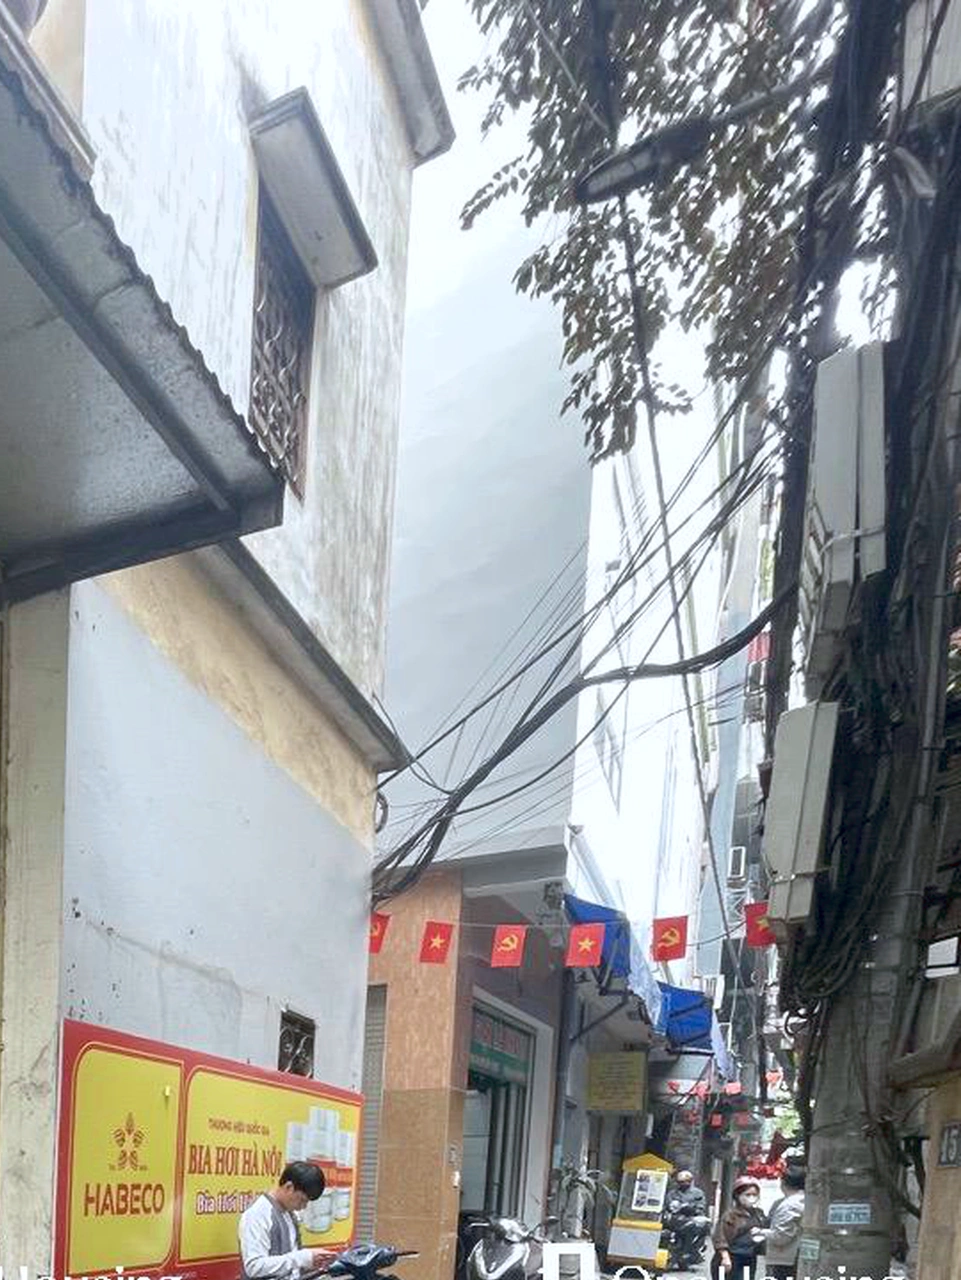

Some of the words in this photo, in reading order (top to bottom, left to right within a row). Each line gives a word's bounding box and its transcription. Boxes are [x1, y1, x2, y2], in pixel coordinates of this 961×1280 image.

[188, 1144, 212, 1175] BIA
[215, 1144, 240, 1176] HƠI
[241, 1140, 259, 1176] HÀ
[84, 1183, 165, 1216] HABECO
